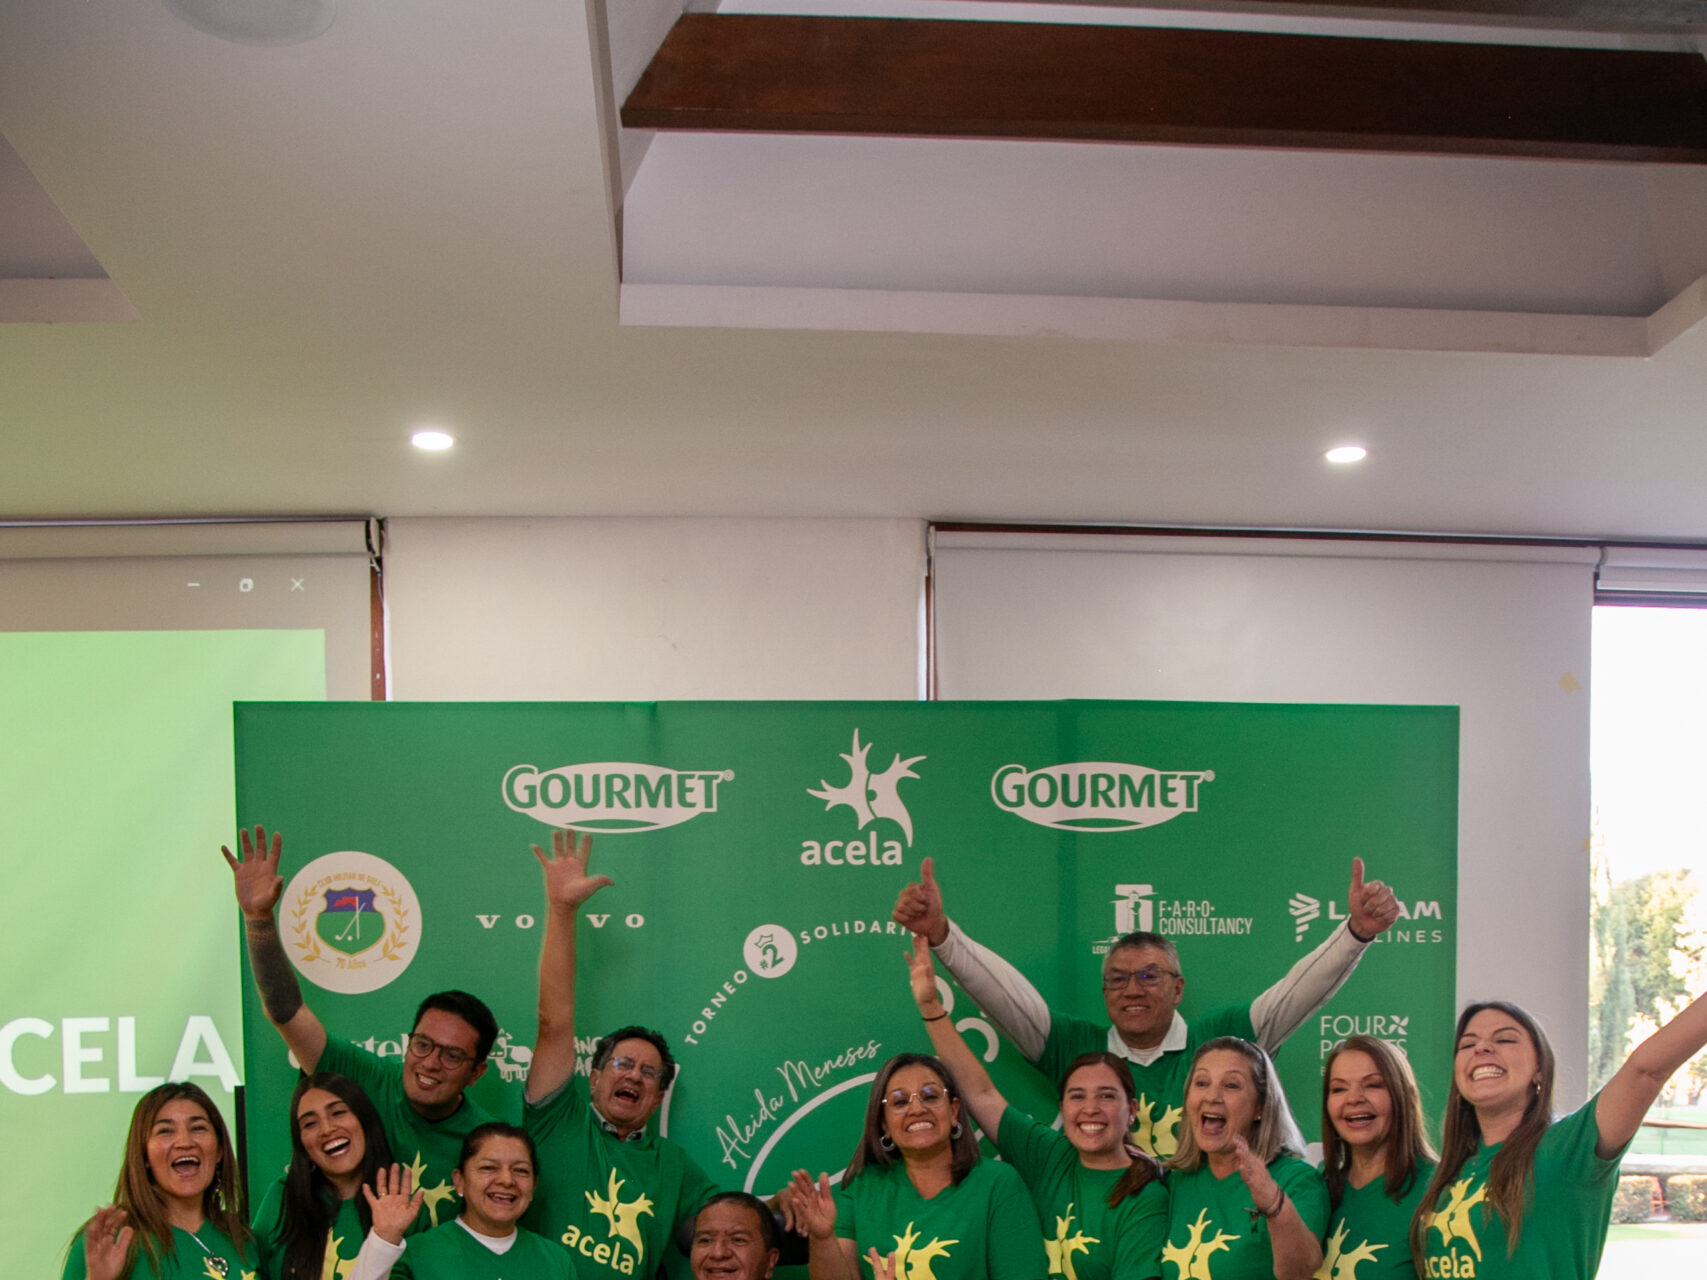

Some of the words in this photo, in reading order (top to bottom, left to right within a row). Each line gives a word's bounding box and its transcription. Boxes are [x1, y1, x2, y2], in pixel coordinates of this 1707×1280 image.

[505, 766, 721, 809] GOURMET
[994, 766, 1202, 809] GOURMET
[800, 830, 903, 866] acela
[475, 913, 645, 929] VOVO
[1159, 917, 1253, 935] CONSULTANCY
[1374, 930, 1443, 943] LINES
[684, 970, 748, 1045] TORNEO
[800, 920, 918, 945] SOLIDARI
[1321, 1015, 1388, 1036] FOUR
[0, 1015, 243, 1096] CELA
[716, 1088, 784, 1170] Aleida
[776, 1039, 882, 1102] Meneses
[561, 1224, 634, 1275] acela
